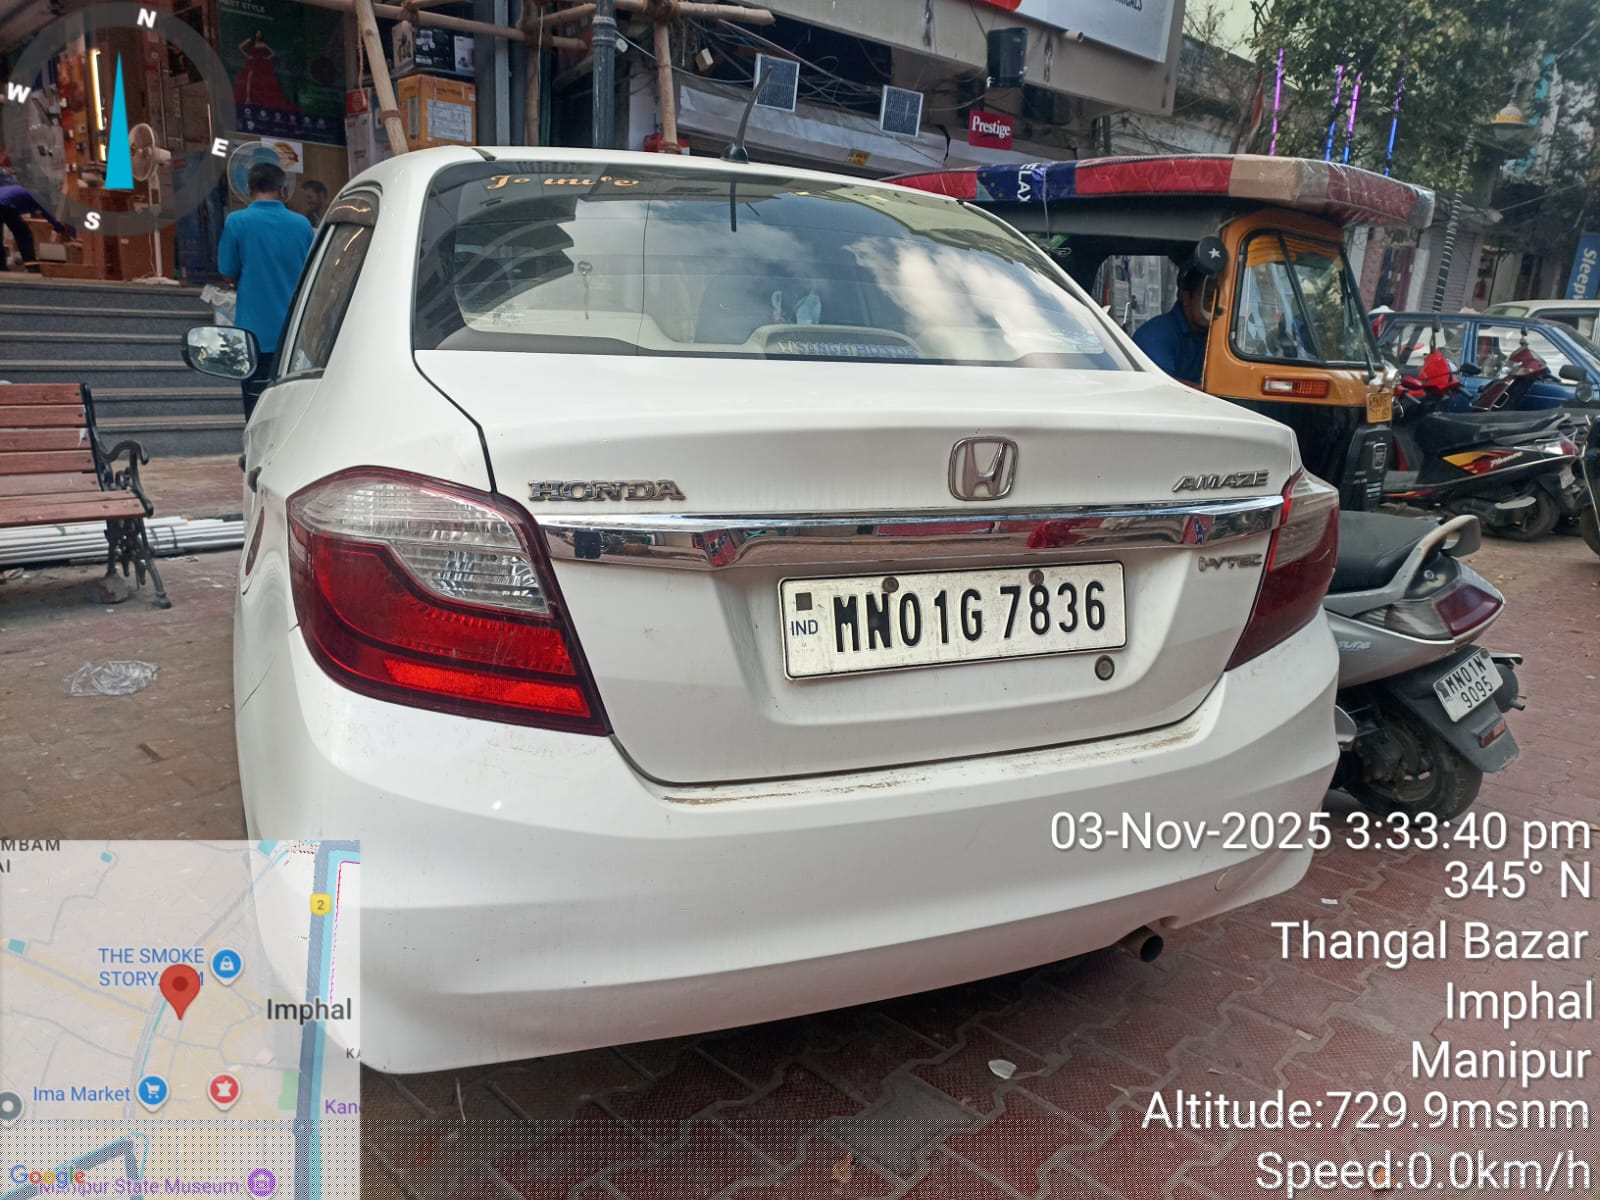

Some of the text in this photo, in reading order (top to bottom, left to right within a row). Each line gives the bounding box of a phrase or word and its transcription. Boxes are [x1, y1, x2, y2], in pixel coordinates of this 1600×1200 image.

[972, 115, 1011, 139] Prestige
[528, 480, 686, 502] HONDA
[1172, 469, 1269, 493] AMAZE
[790, 620, 819, 636] IND
[833, 581, 1106, 653] MN01G 7836
[1460, 675, 1494, 709] 9095
